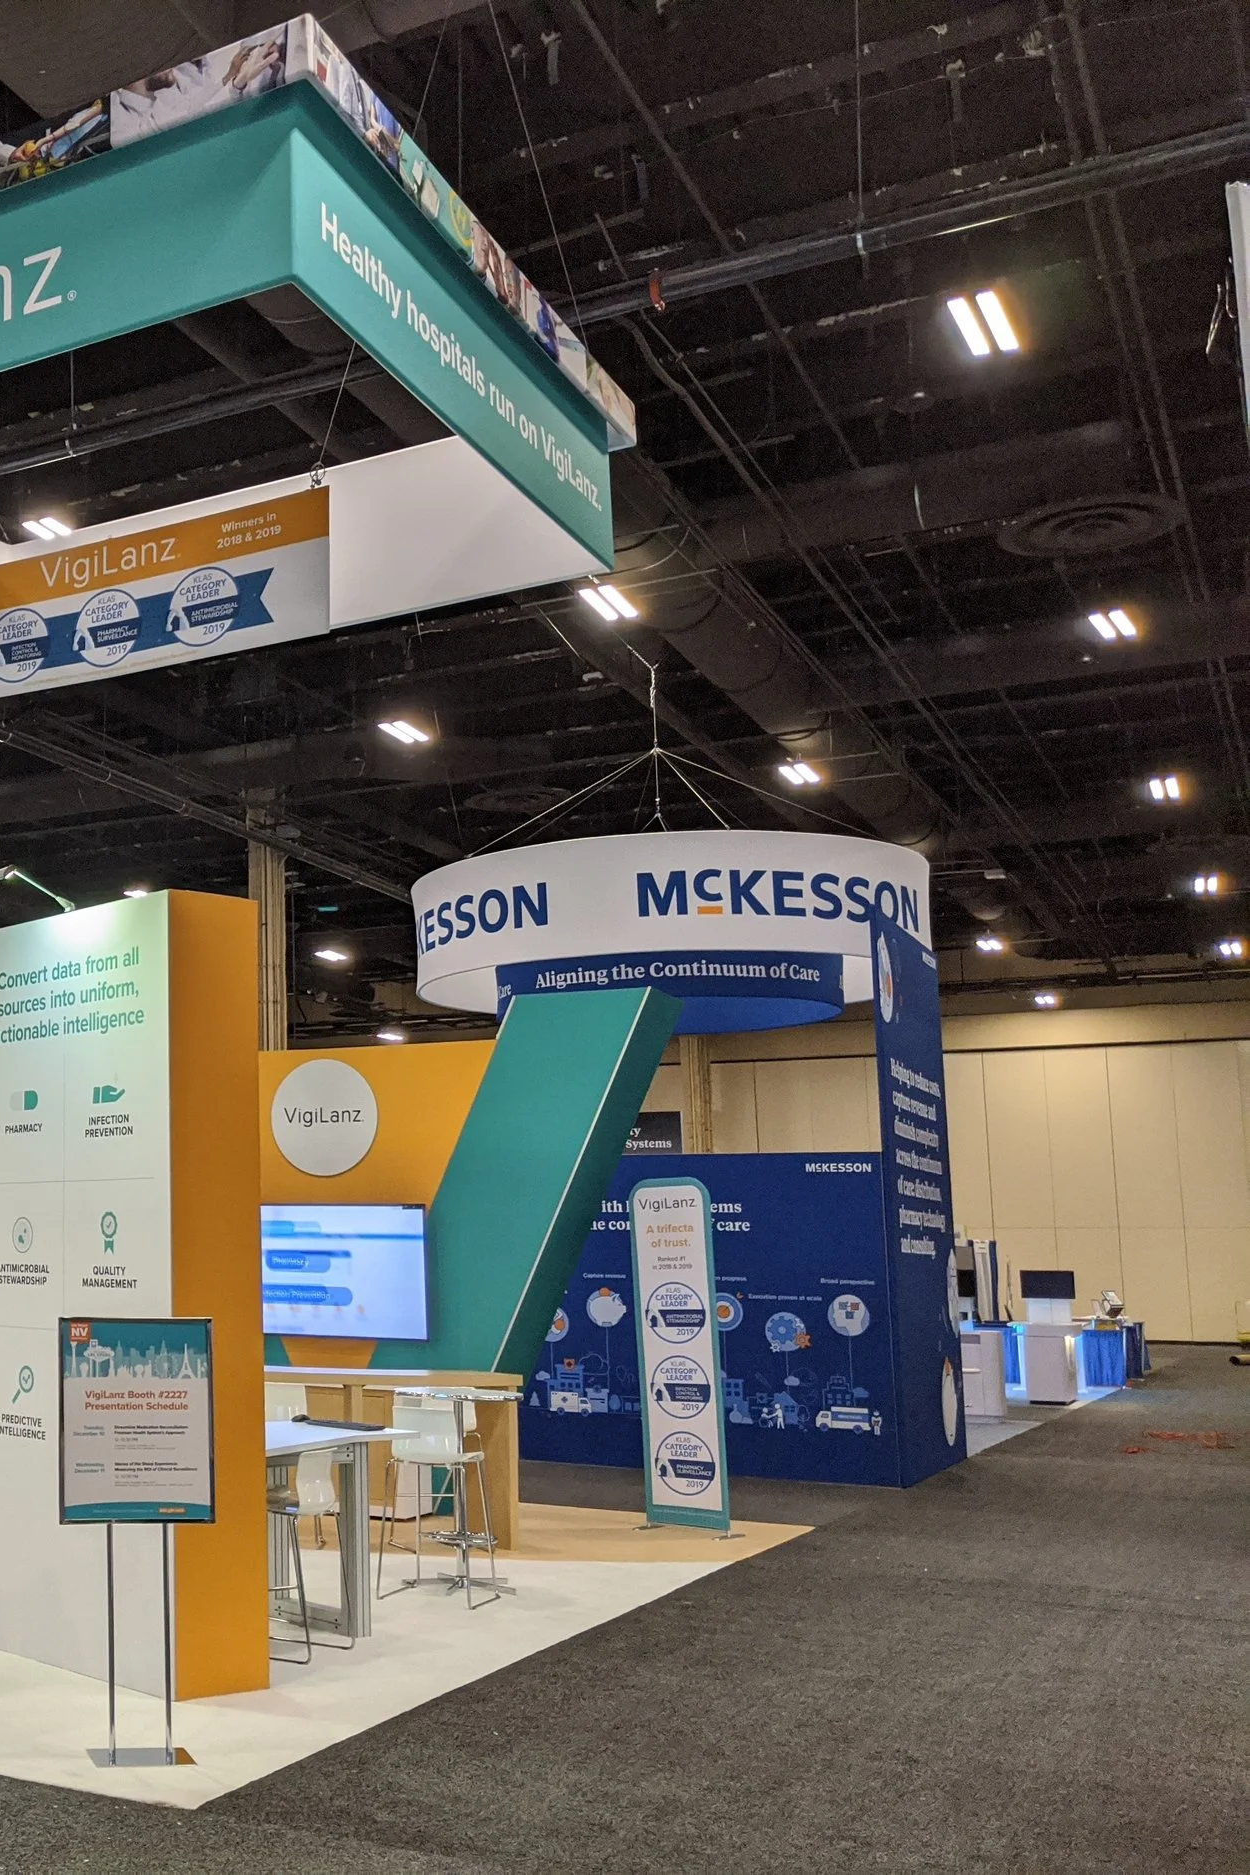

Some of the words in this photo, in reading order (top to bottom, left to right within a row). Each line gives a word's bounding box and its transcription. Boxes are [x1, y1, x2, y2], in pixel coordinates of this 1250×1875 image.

[321, 201, 402, 320] Healthy
[407, 290, 485, 397] hospitals
[489, 380, 516, 428] run
[519, 412, 539, 449] on
[221, 515, 264, 533] Winners
[266, 512, 276, 523] in
[216, 535, 242, 549] 2018
[245, 532, 252, 542] &
[255, 525, 282, 540] 2019
[193, 573, 213, 584] KLAS
[179, 578, 227, 596] CATEGORY
[97, 595, 116, 605] KLAS
[186, 589, 220, 603] LEADER
[85, 601, 129, 617] CATEGORY
[191, 601, 239, 617] ANTIMICROBIAL
[8, 615, 26, 623] KLAS
[91, 610, 122, 623] LEADER
[191, 609, 234, 623] STEWARDSHIP
[2, 629, 32, 641] LEADER
[97, 626, 129, 637] PHARMACY
[203, 623, 225, 635] 2019
[97, 629, 138, 643] SURVEILLANCE
[106, 644, 127, 656] 2019
[17, 661, 37, 672] 2019
[51, 961, 81, 981] data
[85, 955, 118, 974] from
[122, 946, 140, 967] all
[535, 967, 608, 989] Aligning
[612, 963, 645, 981] the
[649, 959, 767, 978] Continuum
[769, 961, 787, 978] of
[790, 963, 819, 981] Care
[50, 990, 76, 1009] into
[80, 980, 140, 1004] uniform,
[63, 1009, 145, 1035] intelligence
[88, 1114, 130, 1126] INFECTION
[5, 1123, 43, 1135] PHARMACY
[84, 1126, 134, 1138] PREVENTION
[625, 1139, 672, 1150] Systems
[646, 1225, 654, 1234] A
[657, 1223, 693, 1233] trifecta
[716, 1220, 751, 1231] care
[651, 1239, 661, 1248] of
[664, 1239, 690, 1247] trust.
[92, 1265, 126, 1277] QUALITY
[82, 1278, 137, 1290] MANAGEMENT
[71, 1327, 89, 1337] NV
[676, 1328, 694, 1336] 2019
[85, 1390, 125, 1400] VigiLanz
[128, 1390, 155, 1399] Booth
[158, 1390, 188, 1399] #2227
[85, 1402, 144, 1411] Presentation
[146, 1402, 189, 1411] Schedule
[1, 1413, 42, 1428] PREDICTIVE
[664, 1444, 703, 1452] CATEGORY
[686, 1480, 704, 1488] 2019
